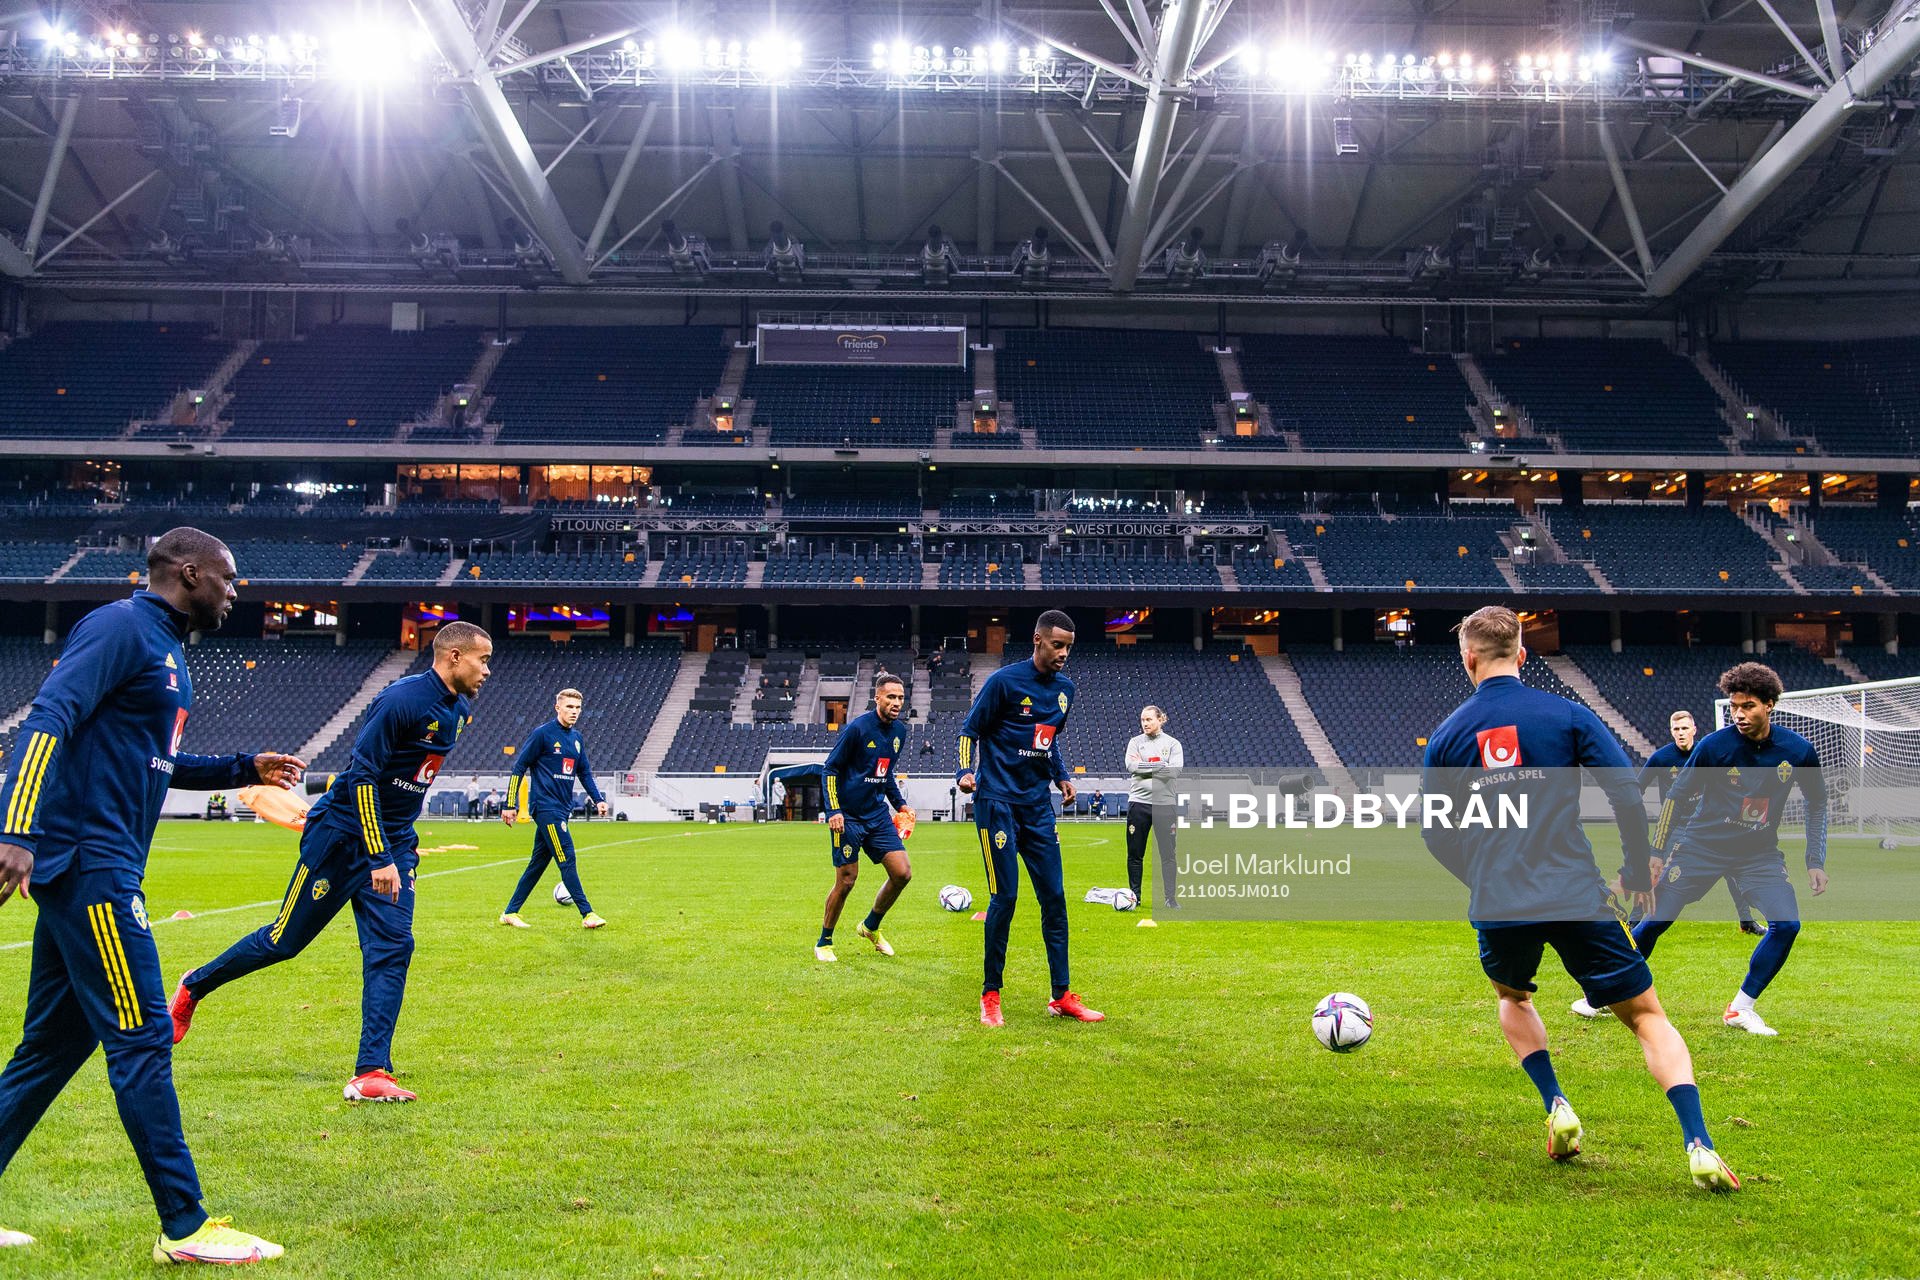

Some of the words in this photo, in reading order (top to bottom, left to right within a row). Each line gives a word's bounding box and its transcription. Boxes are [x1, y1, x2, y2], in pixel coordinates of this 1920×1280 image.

[844, 339, 879, 349] friends
[568, 519, 624, 531] LOUNGE
[1075, 524, 1113, 535] WEST
[1116, 524, 1171, 535] LOUNGE
[1518, 769, 1546, 780] SPEL
[391, 778, 425, 794] SVENSKA
